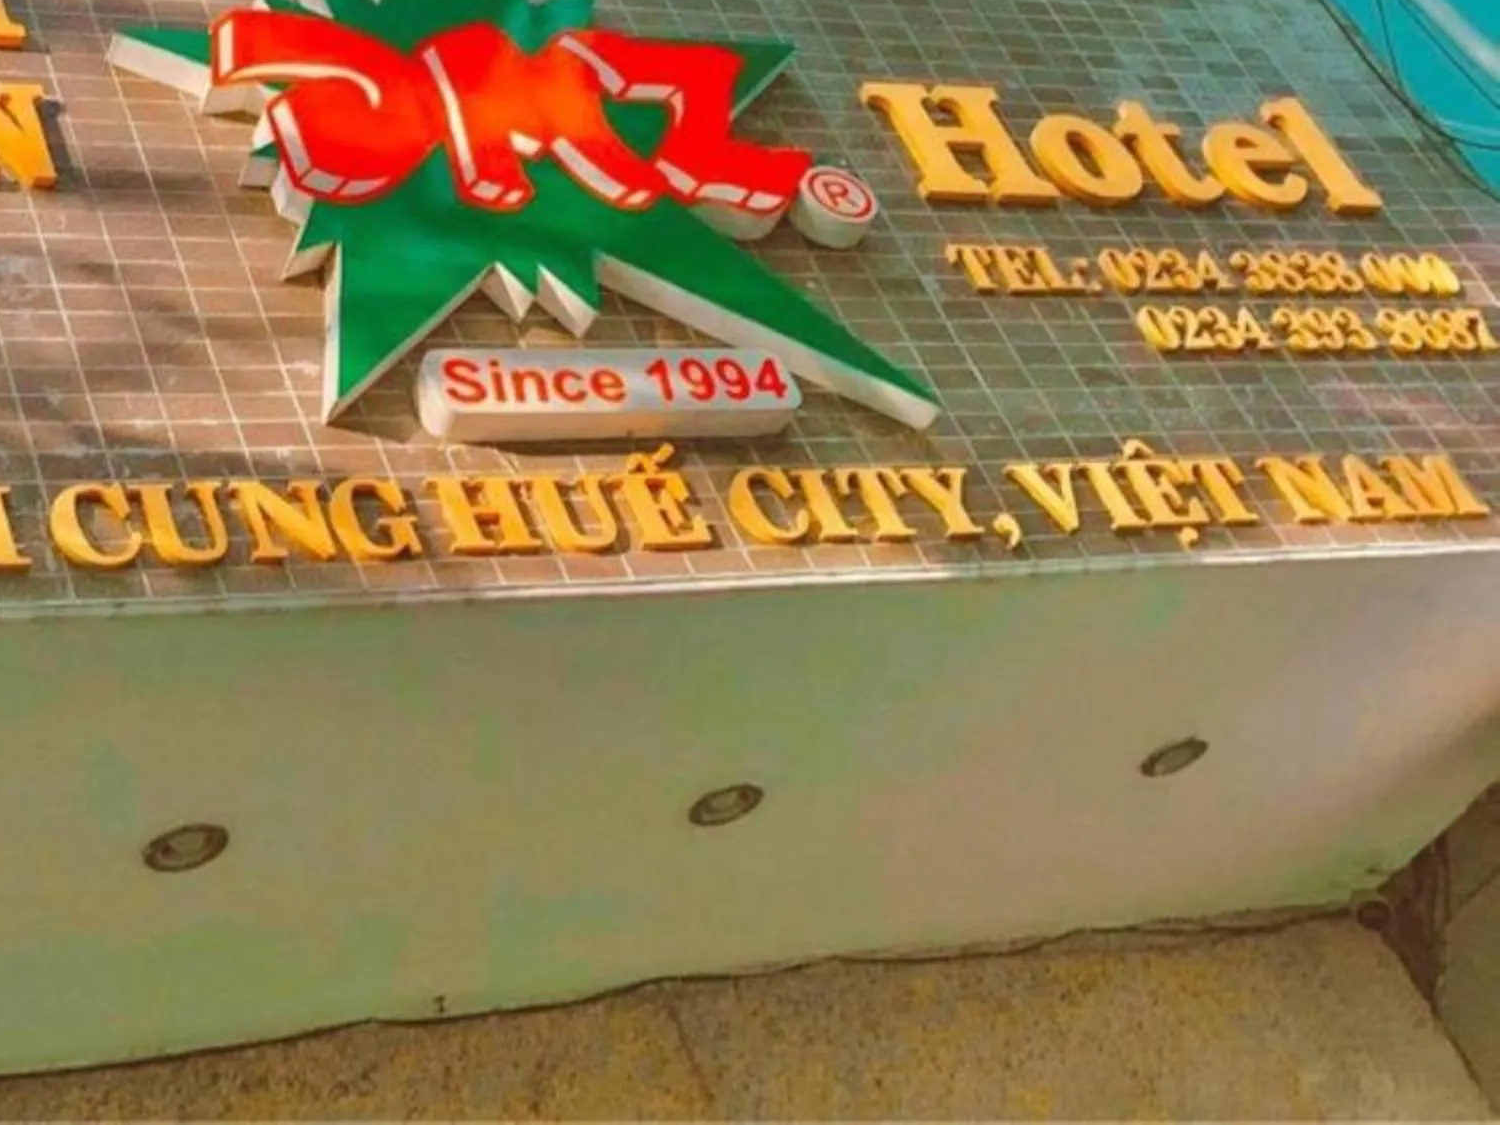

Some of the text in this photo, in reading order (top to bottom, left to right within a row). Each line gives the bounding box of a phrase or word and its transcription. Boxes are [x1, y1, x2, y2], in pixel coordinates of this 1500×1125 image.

[209, 7, 813, 213] DMZ
[858, 82, 1383, 216] Hotel
[442, 356, 789, 407] Since 1994
[1136, 306, 1276, 353] 0234
[49, 478, 421, 571] CUNG
[422, 441, 713, 557] HUẾ
[1254, 453, 1489, 526] NAM
